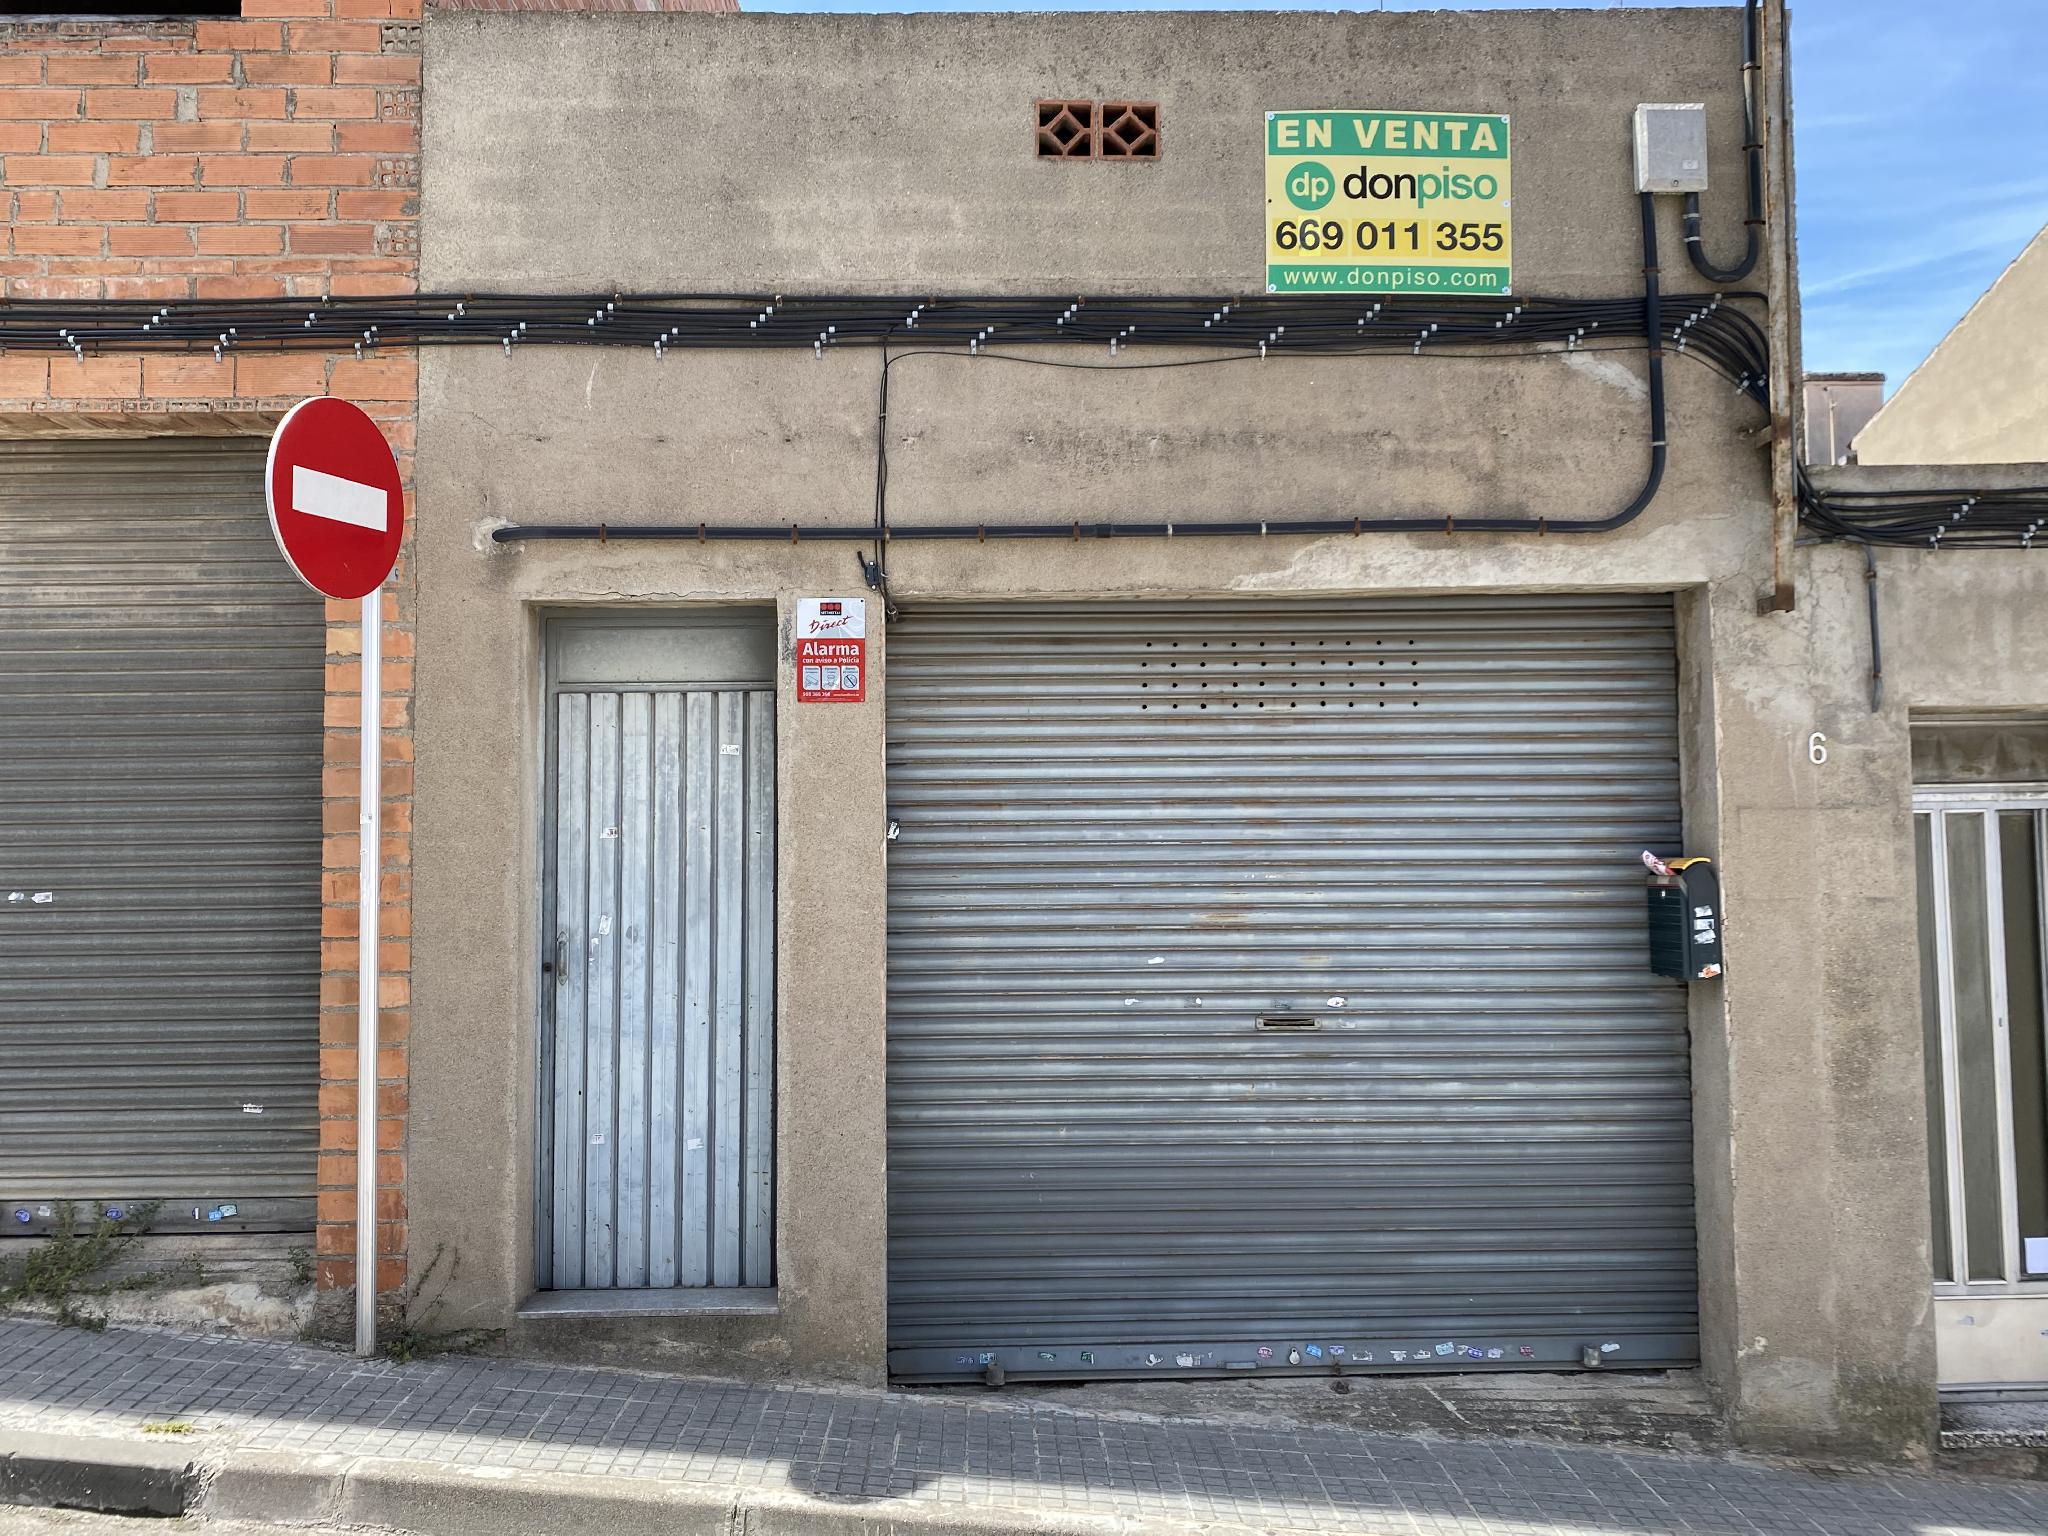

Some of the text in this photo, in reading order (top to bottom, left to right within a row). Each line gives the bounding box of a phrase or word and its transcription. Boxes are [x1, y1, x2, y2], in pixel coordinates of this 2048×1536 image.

[1277, 119, 1498, 151] EN VENTA
[1291, 172, 1329, 202] dp
[1343, 165, 1498, 209] donpiso
[1276, 219, 1504, 251] 669 011 355
[1284, 268, 1497, 289] www.donpiso.com
[808, 615, 853, 634] Direct
[803, 642, 859, 656] Alarma
[1809, 732, 1827, 765] 6
